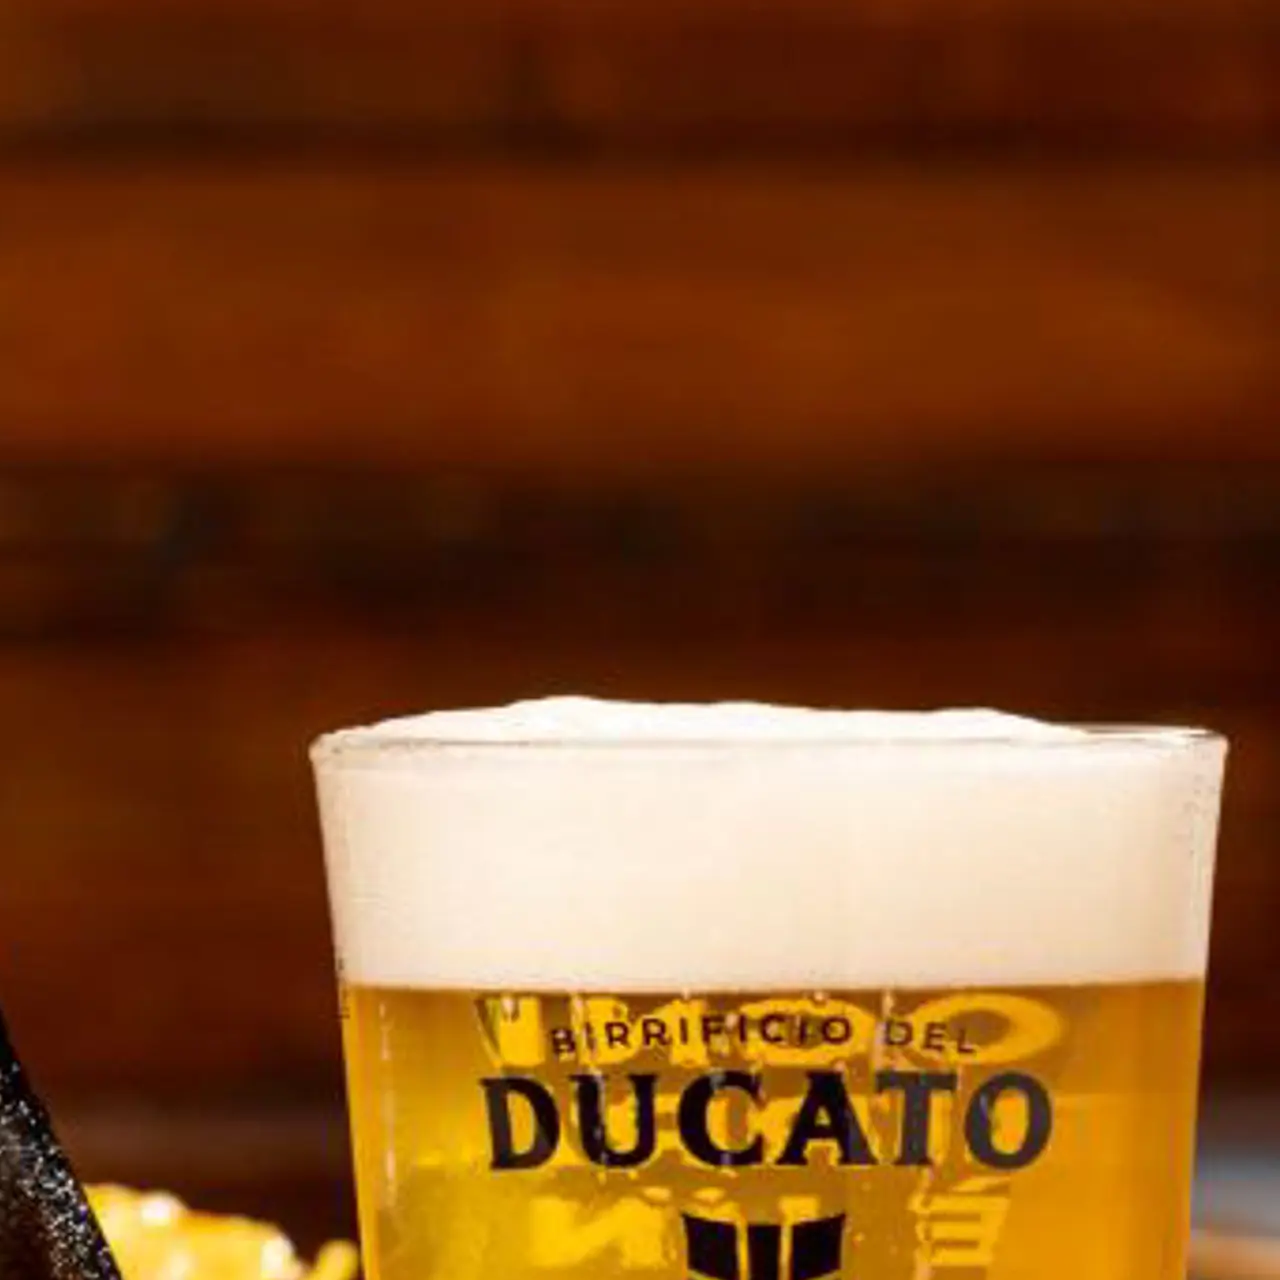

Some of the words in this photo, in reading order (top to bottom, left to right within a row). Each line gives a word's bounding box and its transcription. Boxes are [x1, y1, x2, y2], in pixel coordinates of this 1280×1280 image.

[551, 1013, 853, 1055] BIRRIFICIO
[883, 1021, 977, 1054] DEL
[481, 1071, 1054, 1170] DUCATO
